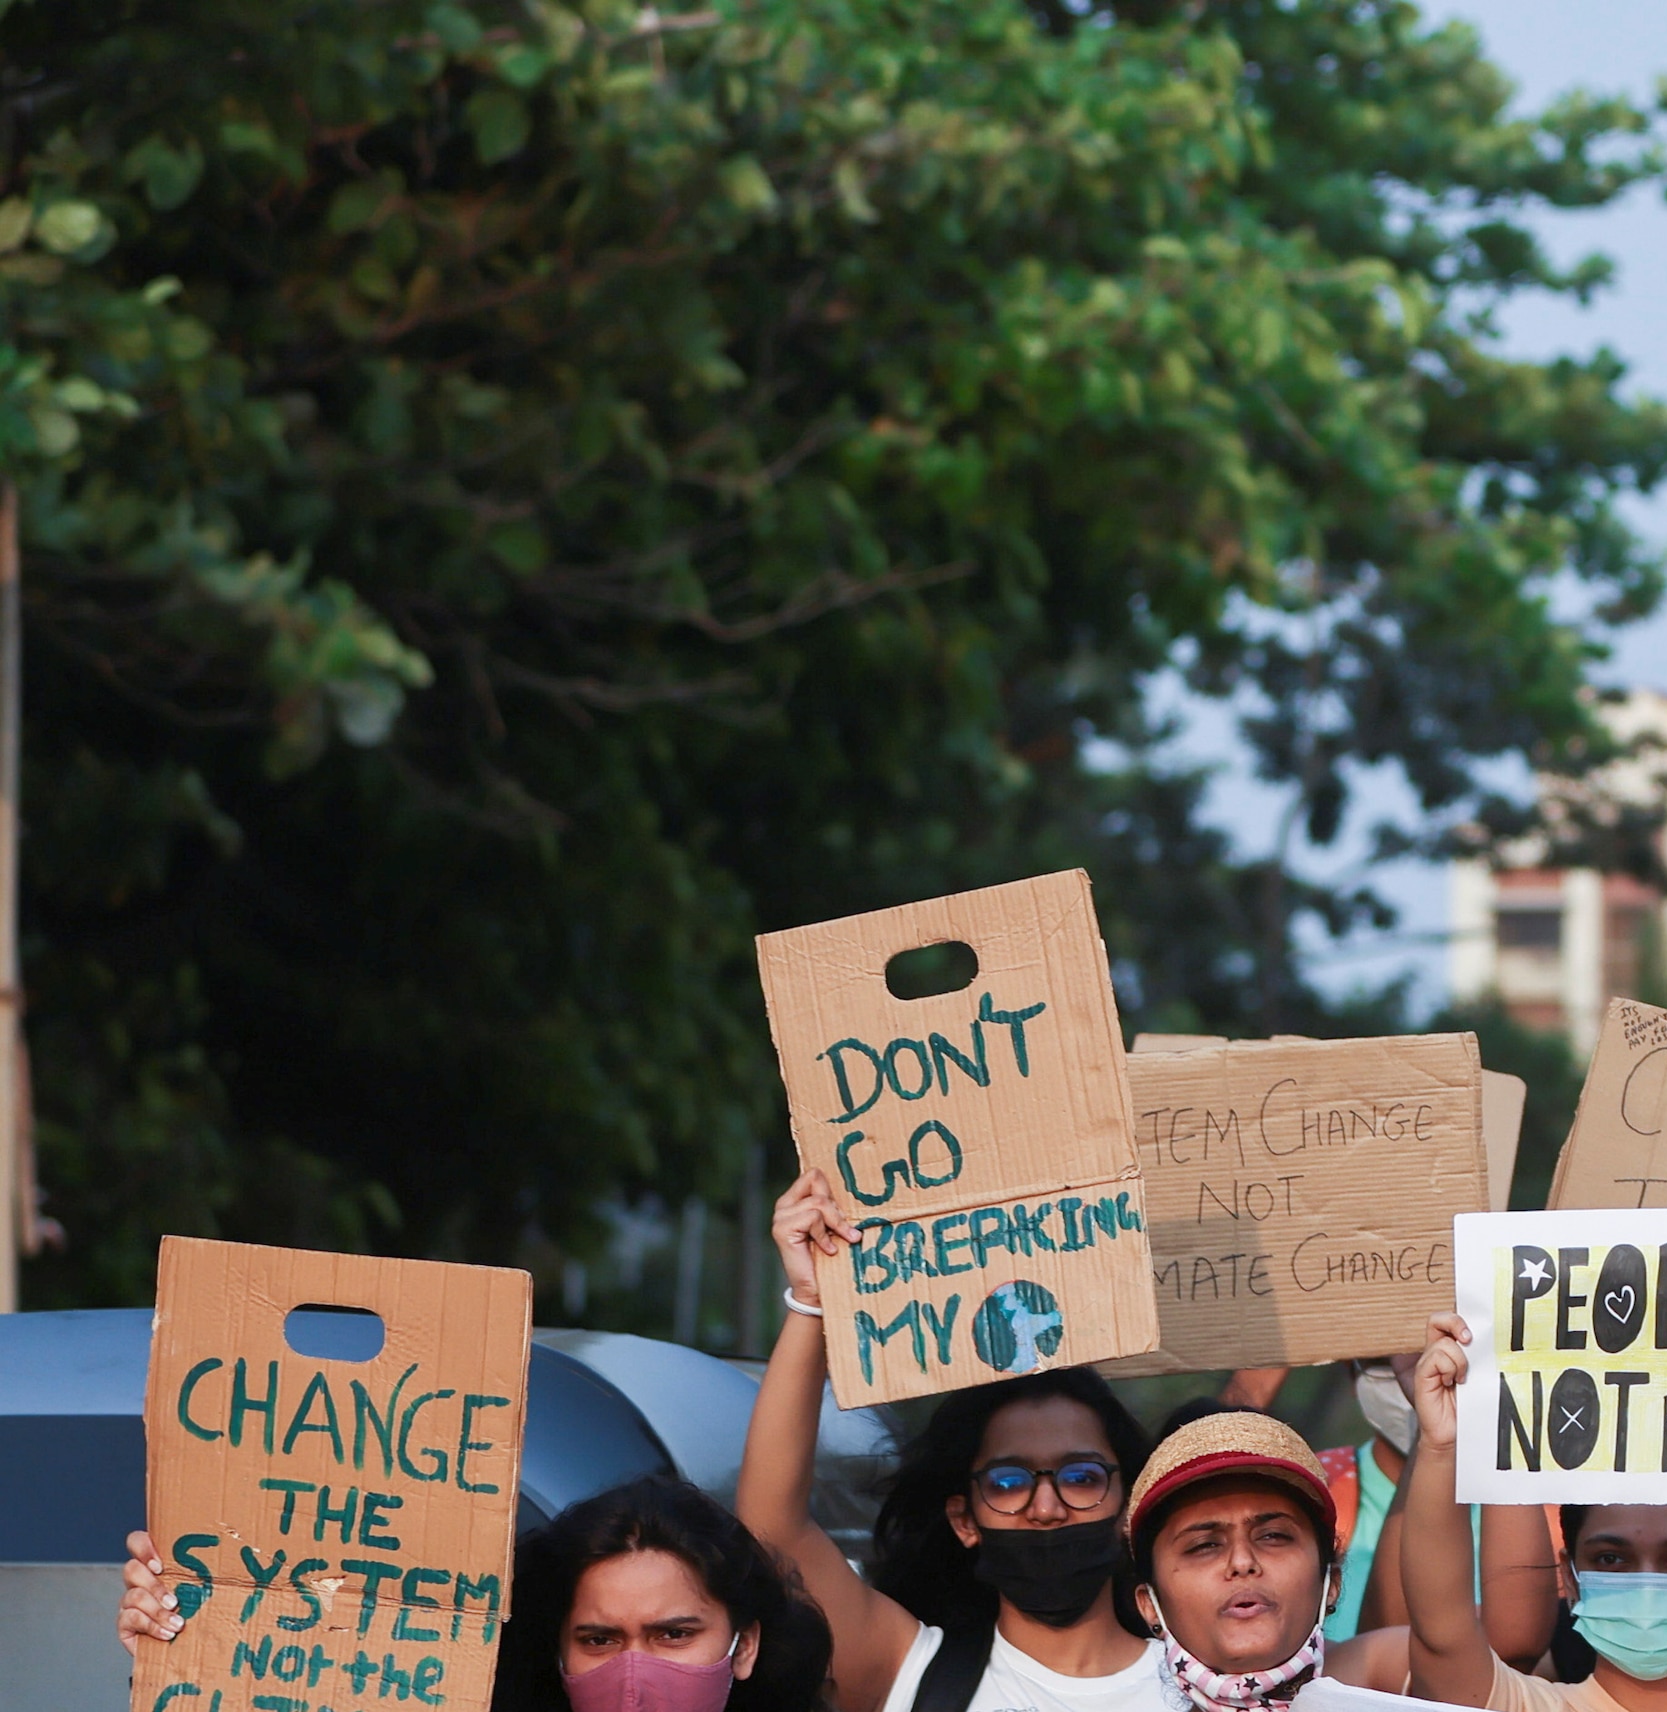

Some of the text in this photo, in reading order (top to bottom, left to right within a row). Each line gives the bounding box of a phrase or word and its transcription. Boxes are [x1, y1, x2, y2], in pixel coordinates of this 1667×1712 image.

[836, 1119, 963, 1207] GO
[1141, 1078, 1433, 1168] TEM CHANGE
[849, 1190, 1147, 1296] BREAKING
[1197, 1174, 1305, 1225] NOT
[1153, 1232, 1449, 1301] MATE CHANGE
[855, 1292, 962, 1386] MY
[176, 1356, 511, 1495] CHANGE
[1495, 1367, 1651, 1473] NOT
[259, 1477, 406, 1552] THE
[170, 1534, 500, 1646] SYSTEM
[341, 1648, 447, 1707] the
